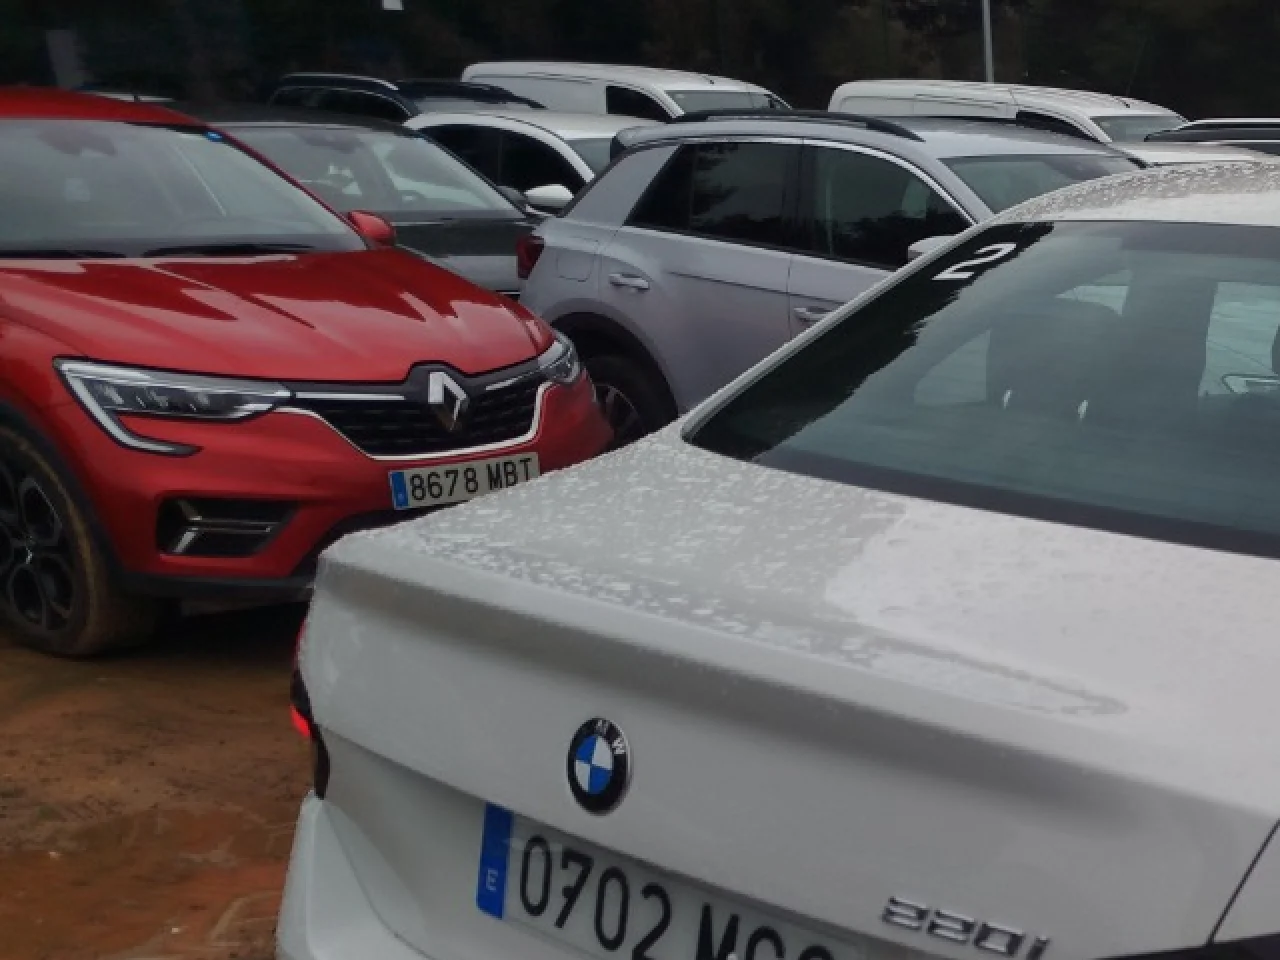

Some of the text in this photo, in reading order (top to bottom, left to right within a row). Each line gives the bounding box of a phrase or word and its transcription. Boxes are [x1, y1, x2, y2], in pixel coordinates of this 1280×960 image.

[409, 457, 533, 501] 8678 MBT
[485, 868, 499, 892] E
